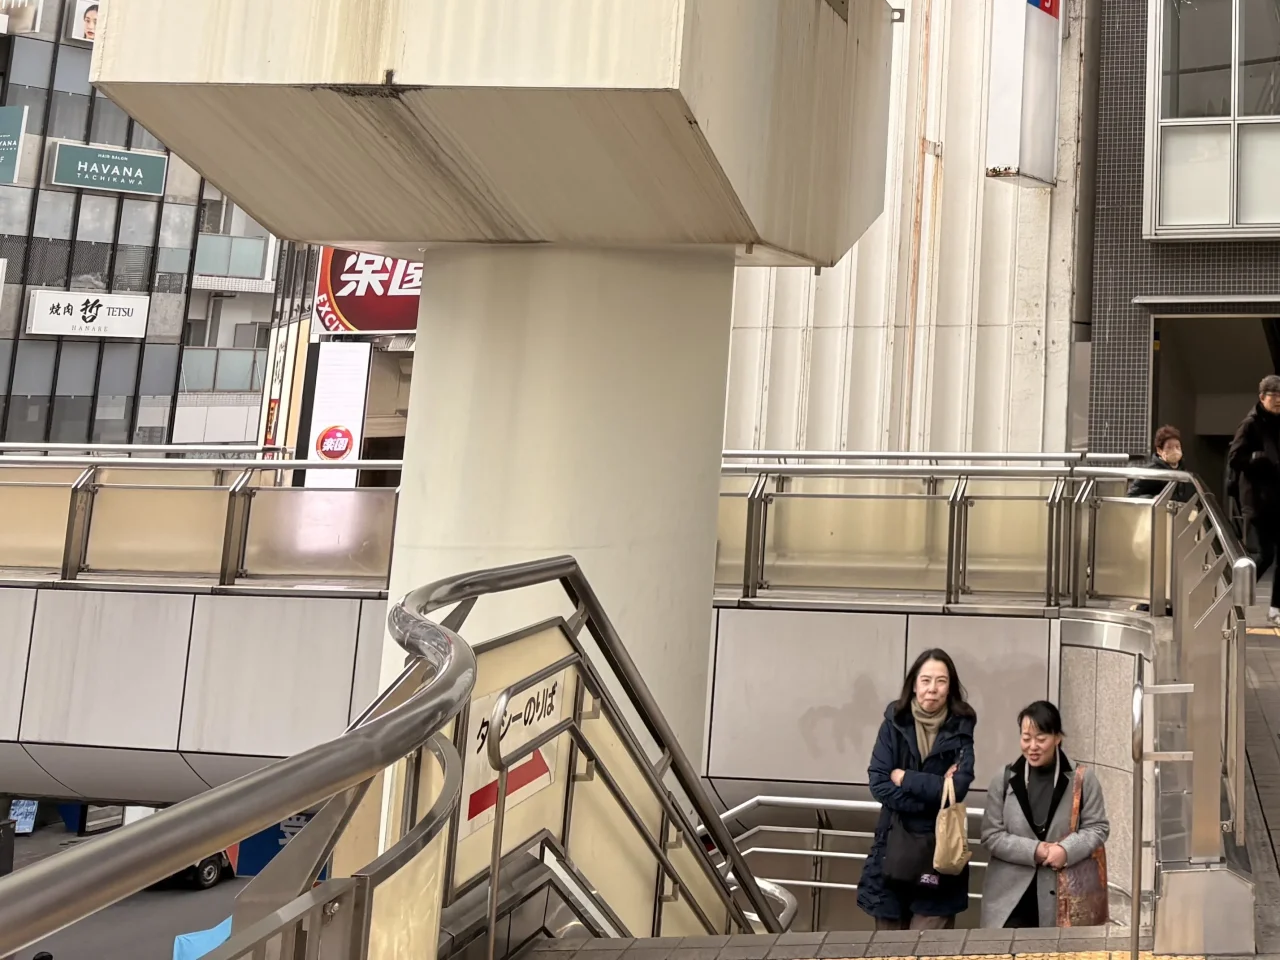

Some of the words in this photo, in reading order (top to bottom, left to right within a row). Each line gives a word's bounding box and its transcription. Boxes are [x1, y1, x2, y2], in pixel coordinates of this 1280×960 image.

[78, 161, 143, 178] HAVANA
[78, 173, 143, 185] TACHIKAWA
[49, 302, 74, 316] 焼肉
[106, 307, 134, 317] TETSU
[477, 681, 558, 754] タシーのりば
